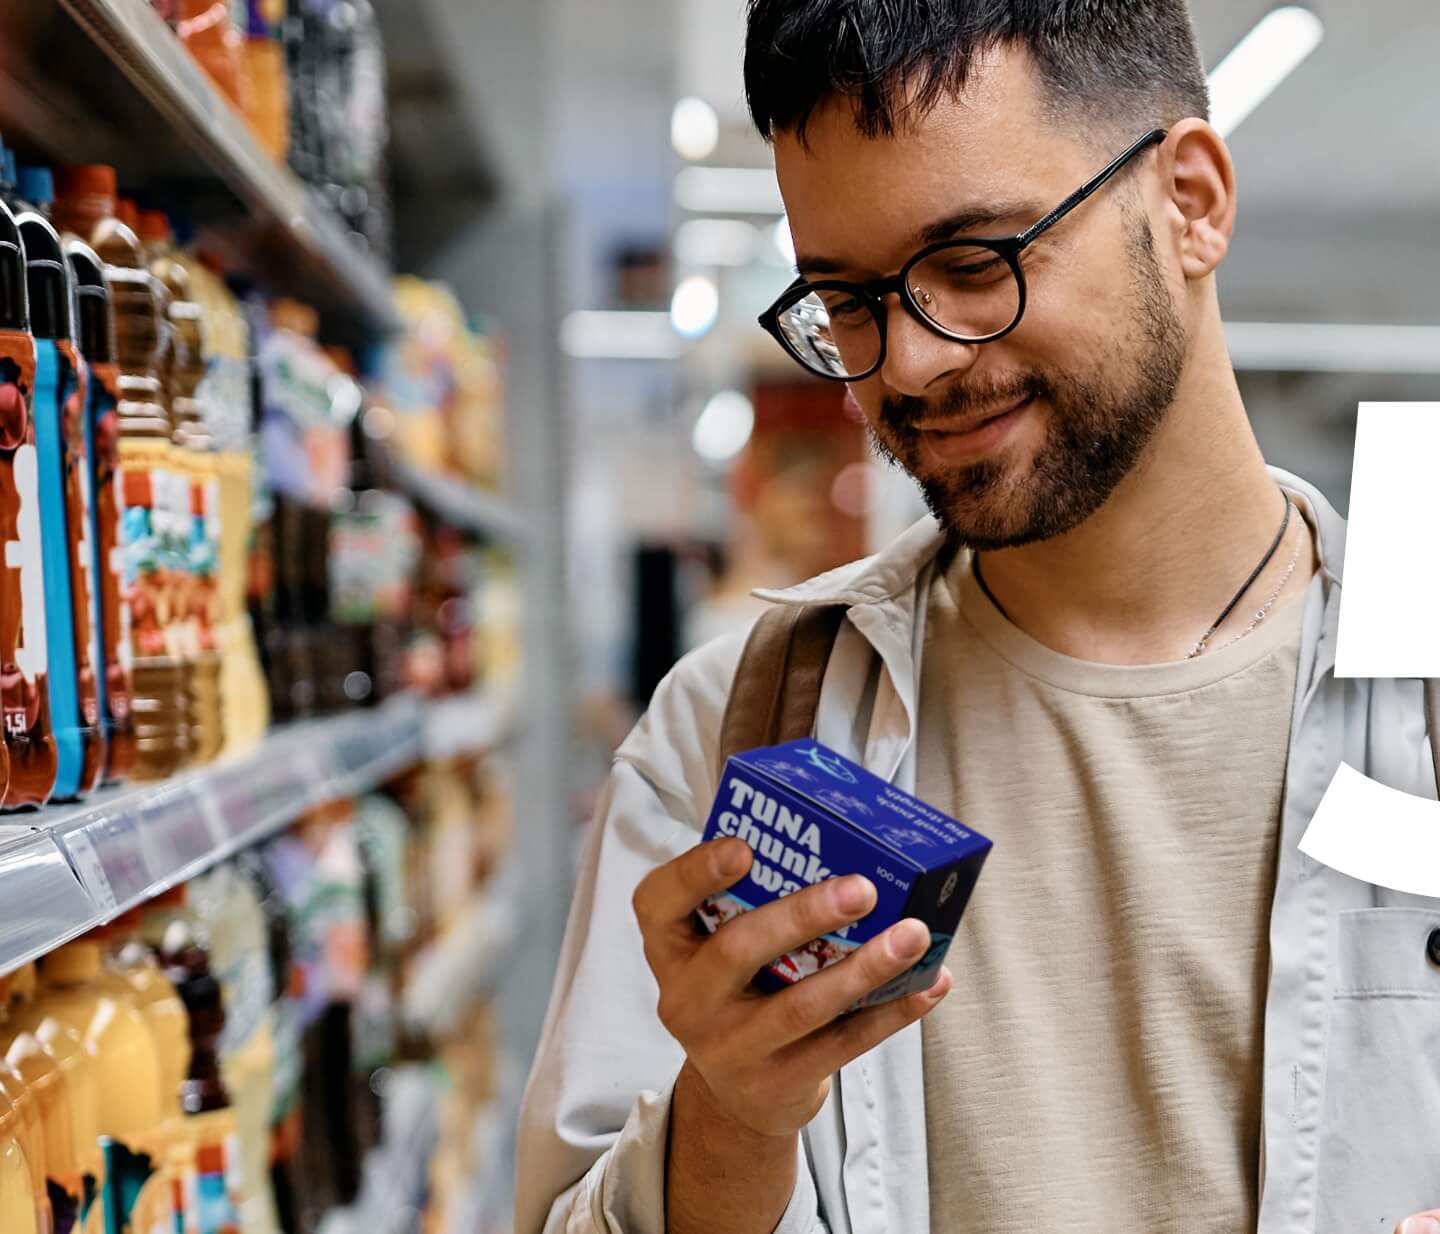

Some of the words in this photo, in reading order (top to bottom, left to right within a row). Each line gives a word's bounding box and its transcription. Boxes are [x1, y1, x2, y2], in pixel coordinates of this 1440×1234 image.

[718, 811, 839, 884] chunk
[729, 778, 820, 855] TUNA
[876, 866, 895, 882] 100
[895, 879, 910, 891] ml
